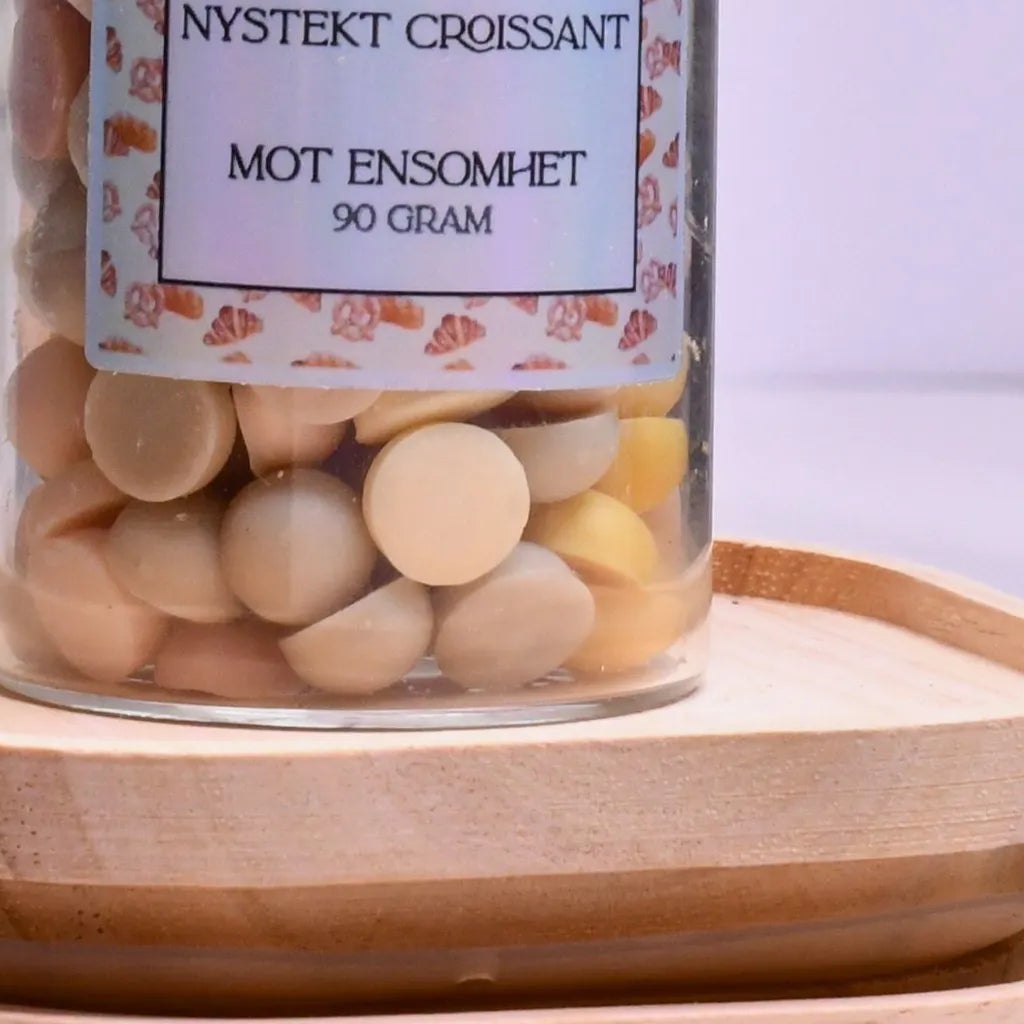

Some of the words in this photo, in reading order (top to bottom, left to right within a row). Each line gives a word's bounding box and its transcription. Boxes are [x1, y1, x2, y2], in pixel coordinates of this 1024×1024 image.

[181, 4, 392, 48] NYSTEKT
[405, 13, 630, 52] CROISSANT
[228, 143, 333, 184] MOT
[347, 149, 587, 188] ENSOMHET
[332, 203, 375, 234] 90
[387, 204, 493, 235] GRAM
